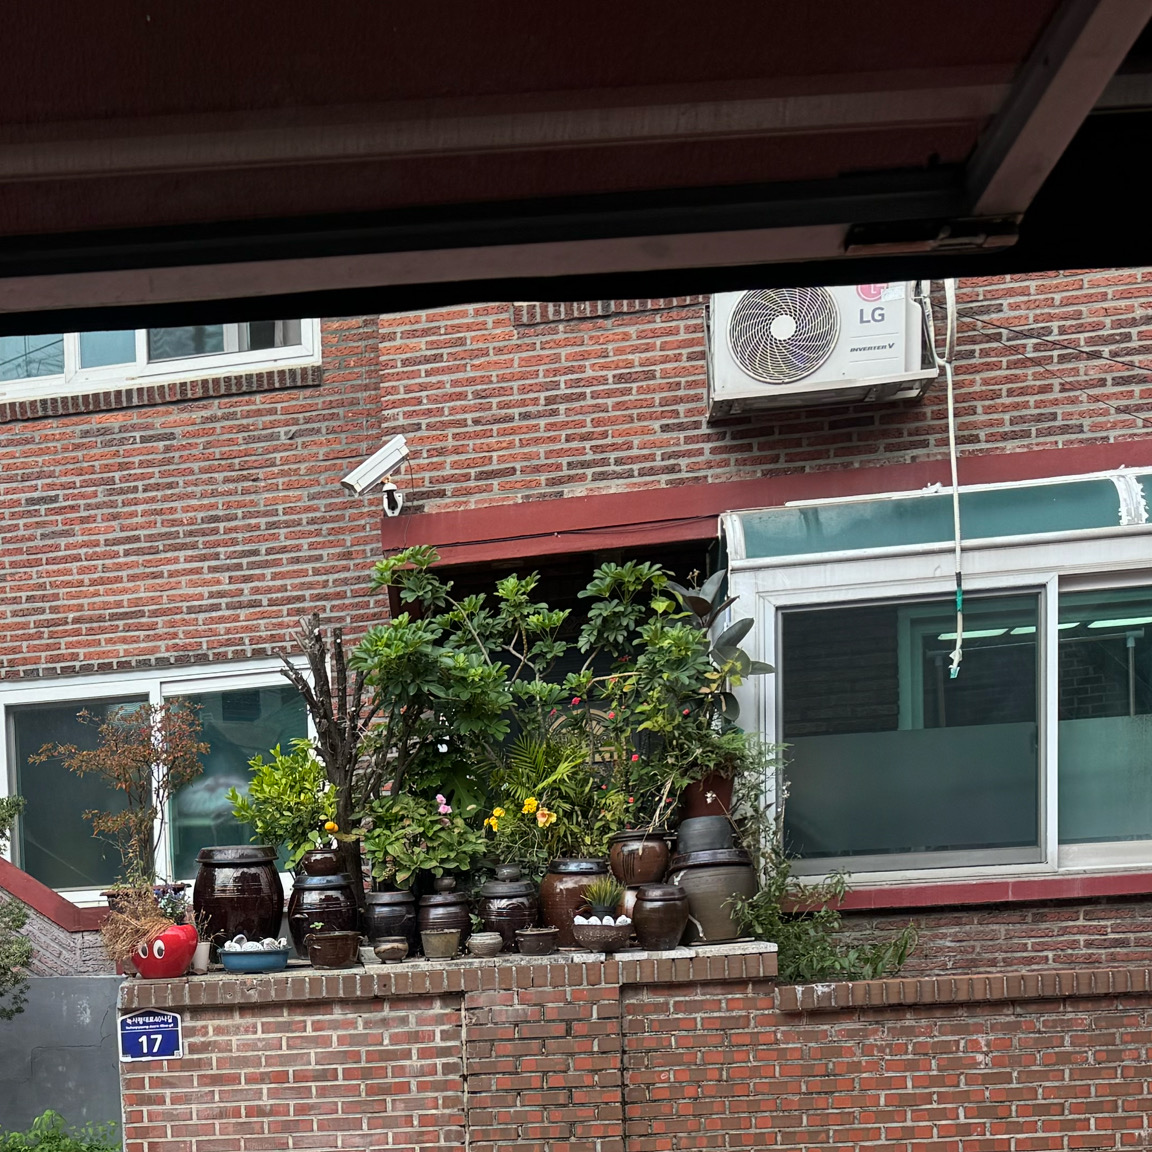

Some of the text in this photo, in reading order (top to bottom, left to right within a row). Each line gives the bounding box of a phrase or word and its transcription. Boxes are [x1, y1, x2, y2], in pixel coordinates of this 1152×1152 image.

[859, 306, 885, 324] LG
[850, 344, 887, 352] INVERTER
[138, 1034, 163, 1054] 17
